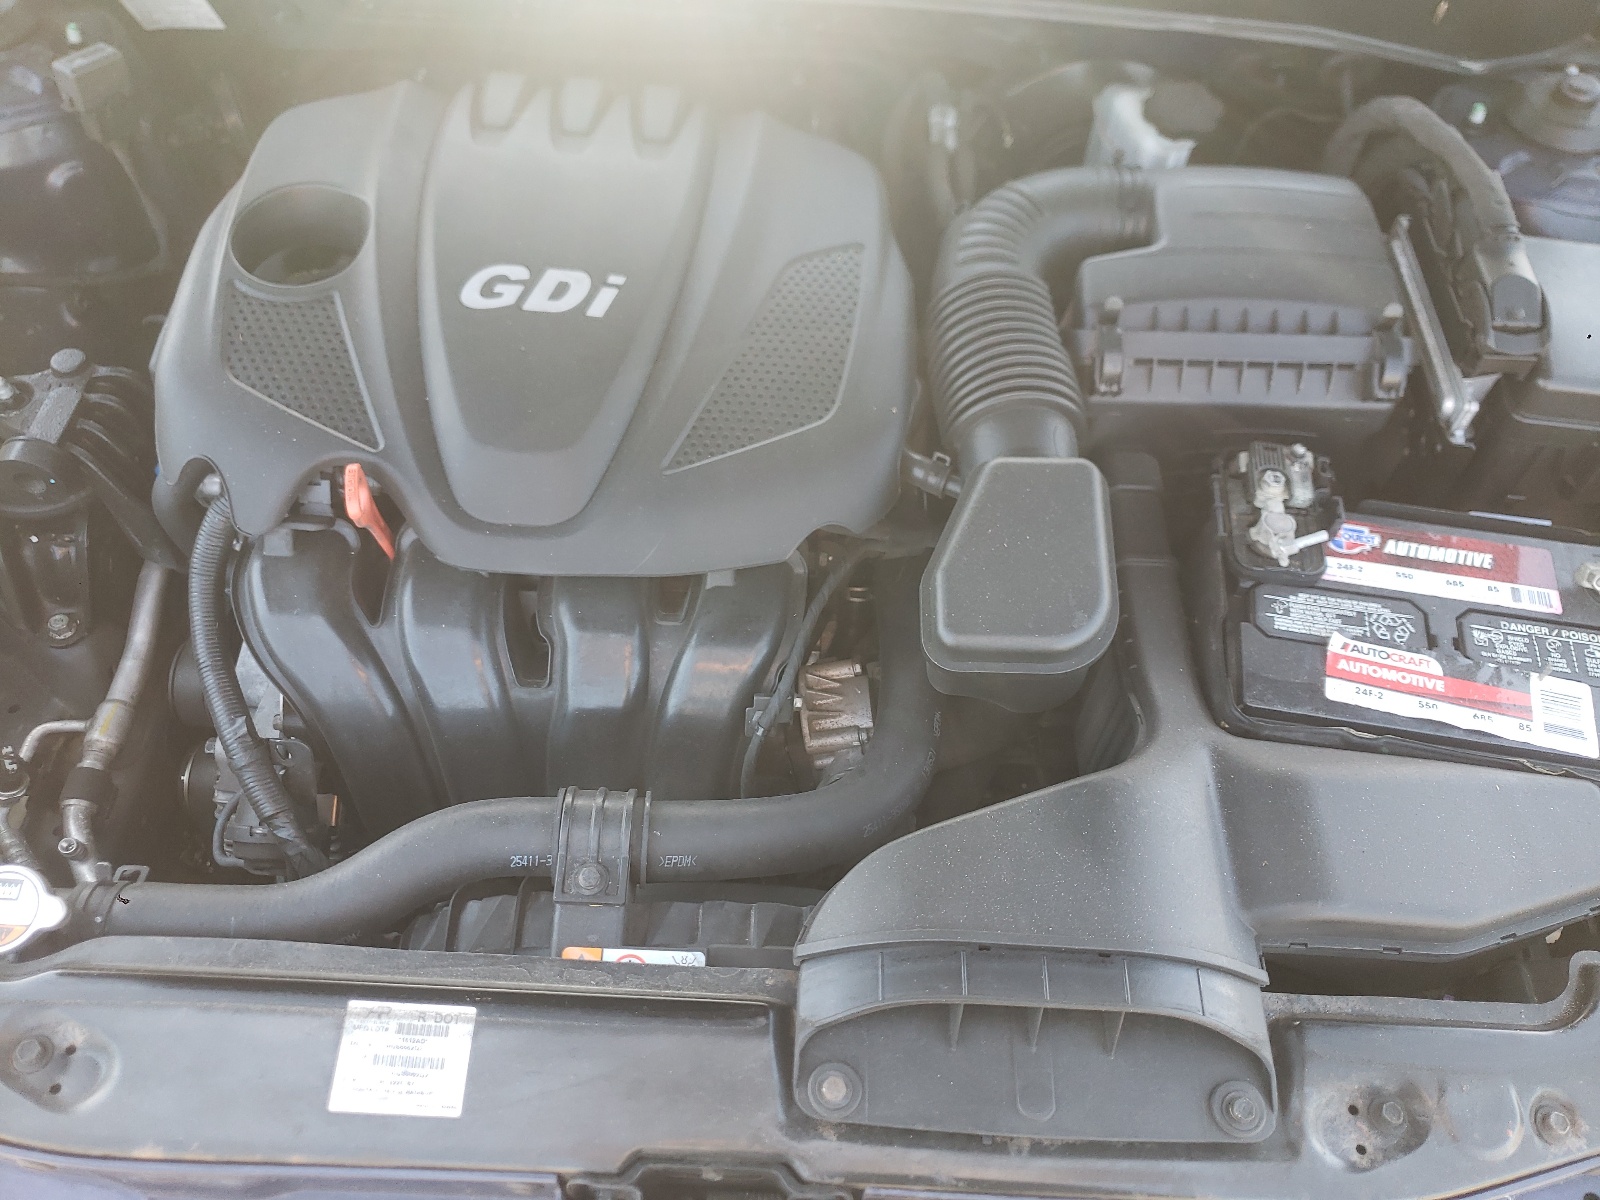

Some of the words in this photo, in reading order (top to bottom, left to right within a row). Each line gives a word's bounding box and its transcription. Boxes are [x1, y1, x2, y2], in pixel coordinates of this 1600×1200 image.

[460, 264, 627, 318] GDi
[1384, 539, 1494, 569] AUTOMOTIVE
[1500, 621, 1549, 636] DANGER
[1350, 644, 1431, 668] AUTOCRAFT
[1337, 659, 1445, 692] AUTOMOTIVE
[1519, 722, 1532, 732] 85
